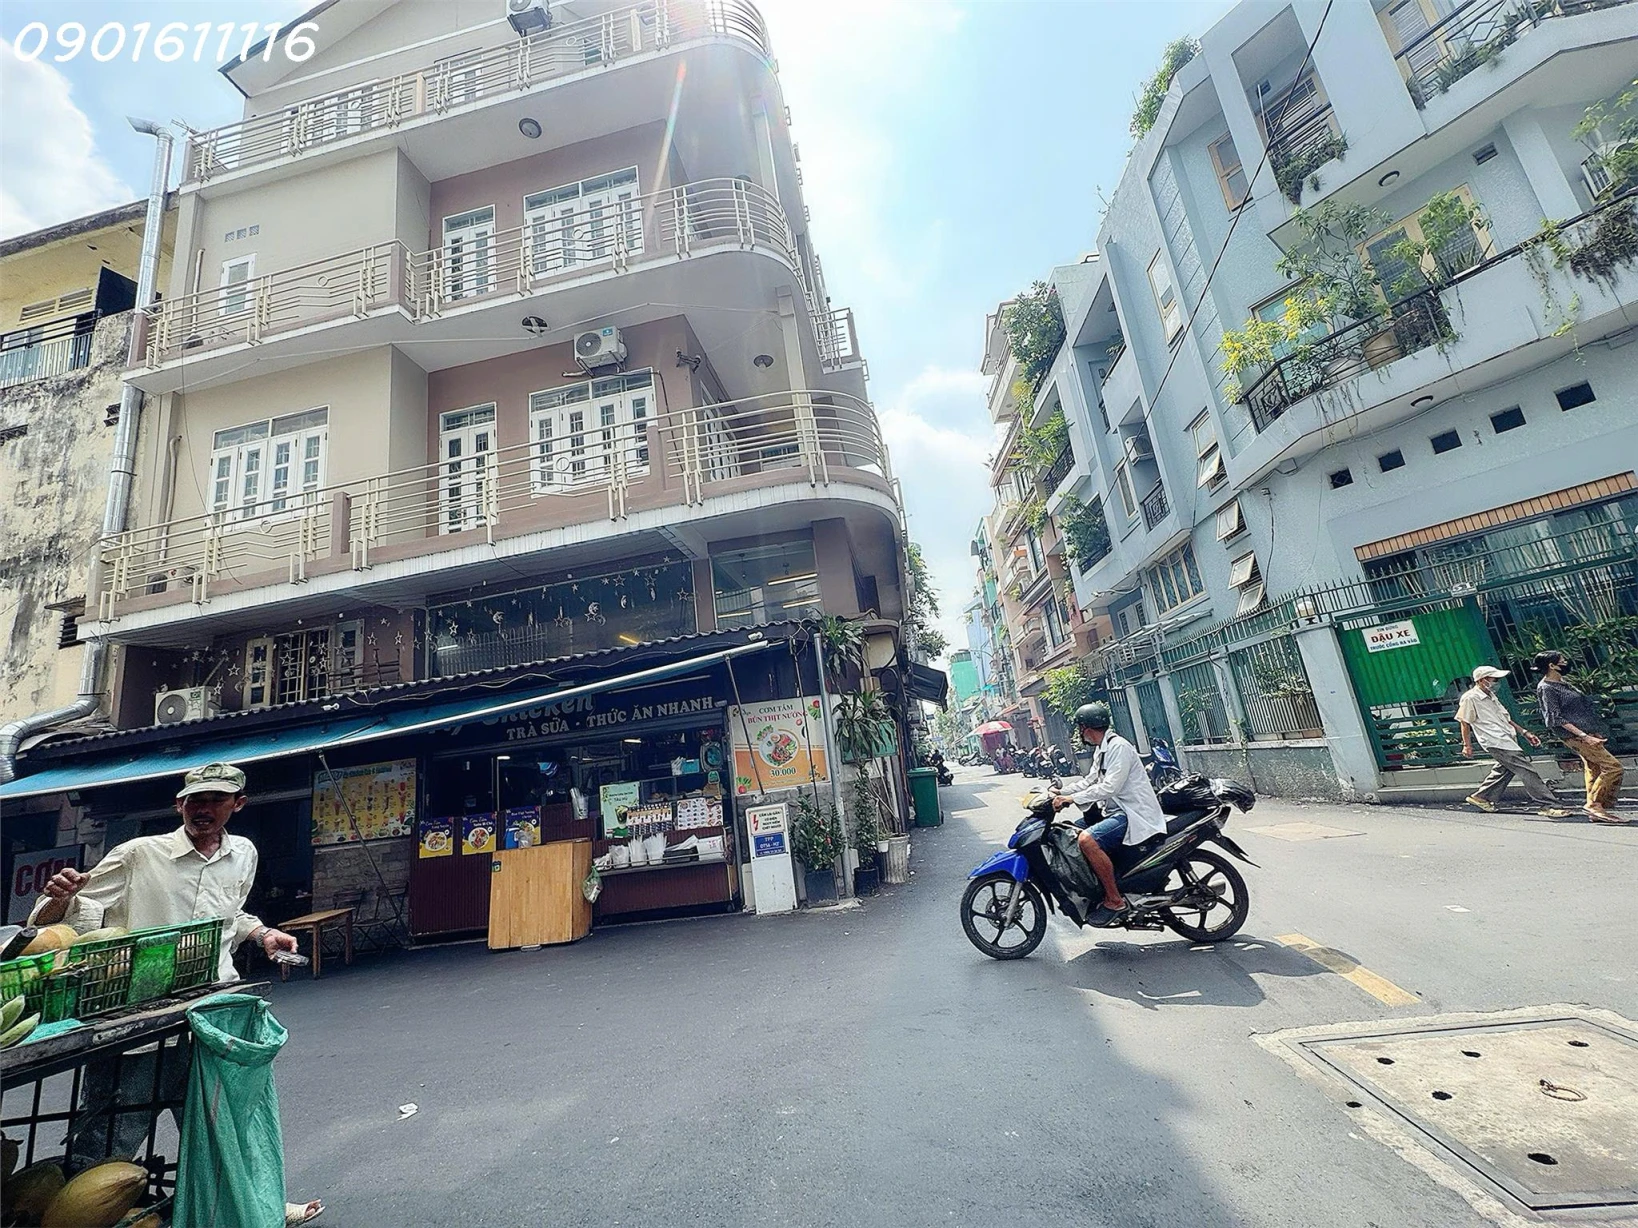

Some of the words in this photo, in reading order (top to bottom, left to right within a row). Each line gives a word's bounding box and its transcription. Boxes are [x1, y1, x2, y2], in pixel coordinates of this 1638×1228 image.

[1371, 632, 1393, 644] ĐẬU
[1396, 629, 1411, 639] XE
[507, 721, 538, 741] TRÀ
[541, 716, 569, 735] SỮA
[587, 708, 627, 728] THỨC
[632, 705, 653, 721] ĂN
[657, 697, 713, 717] NHANH
